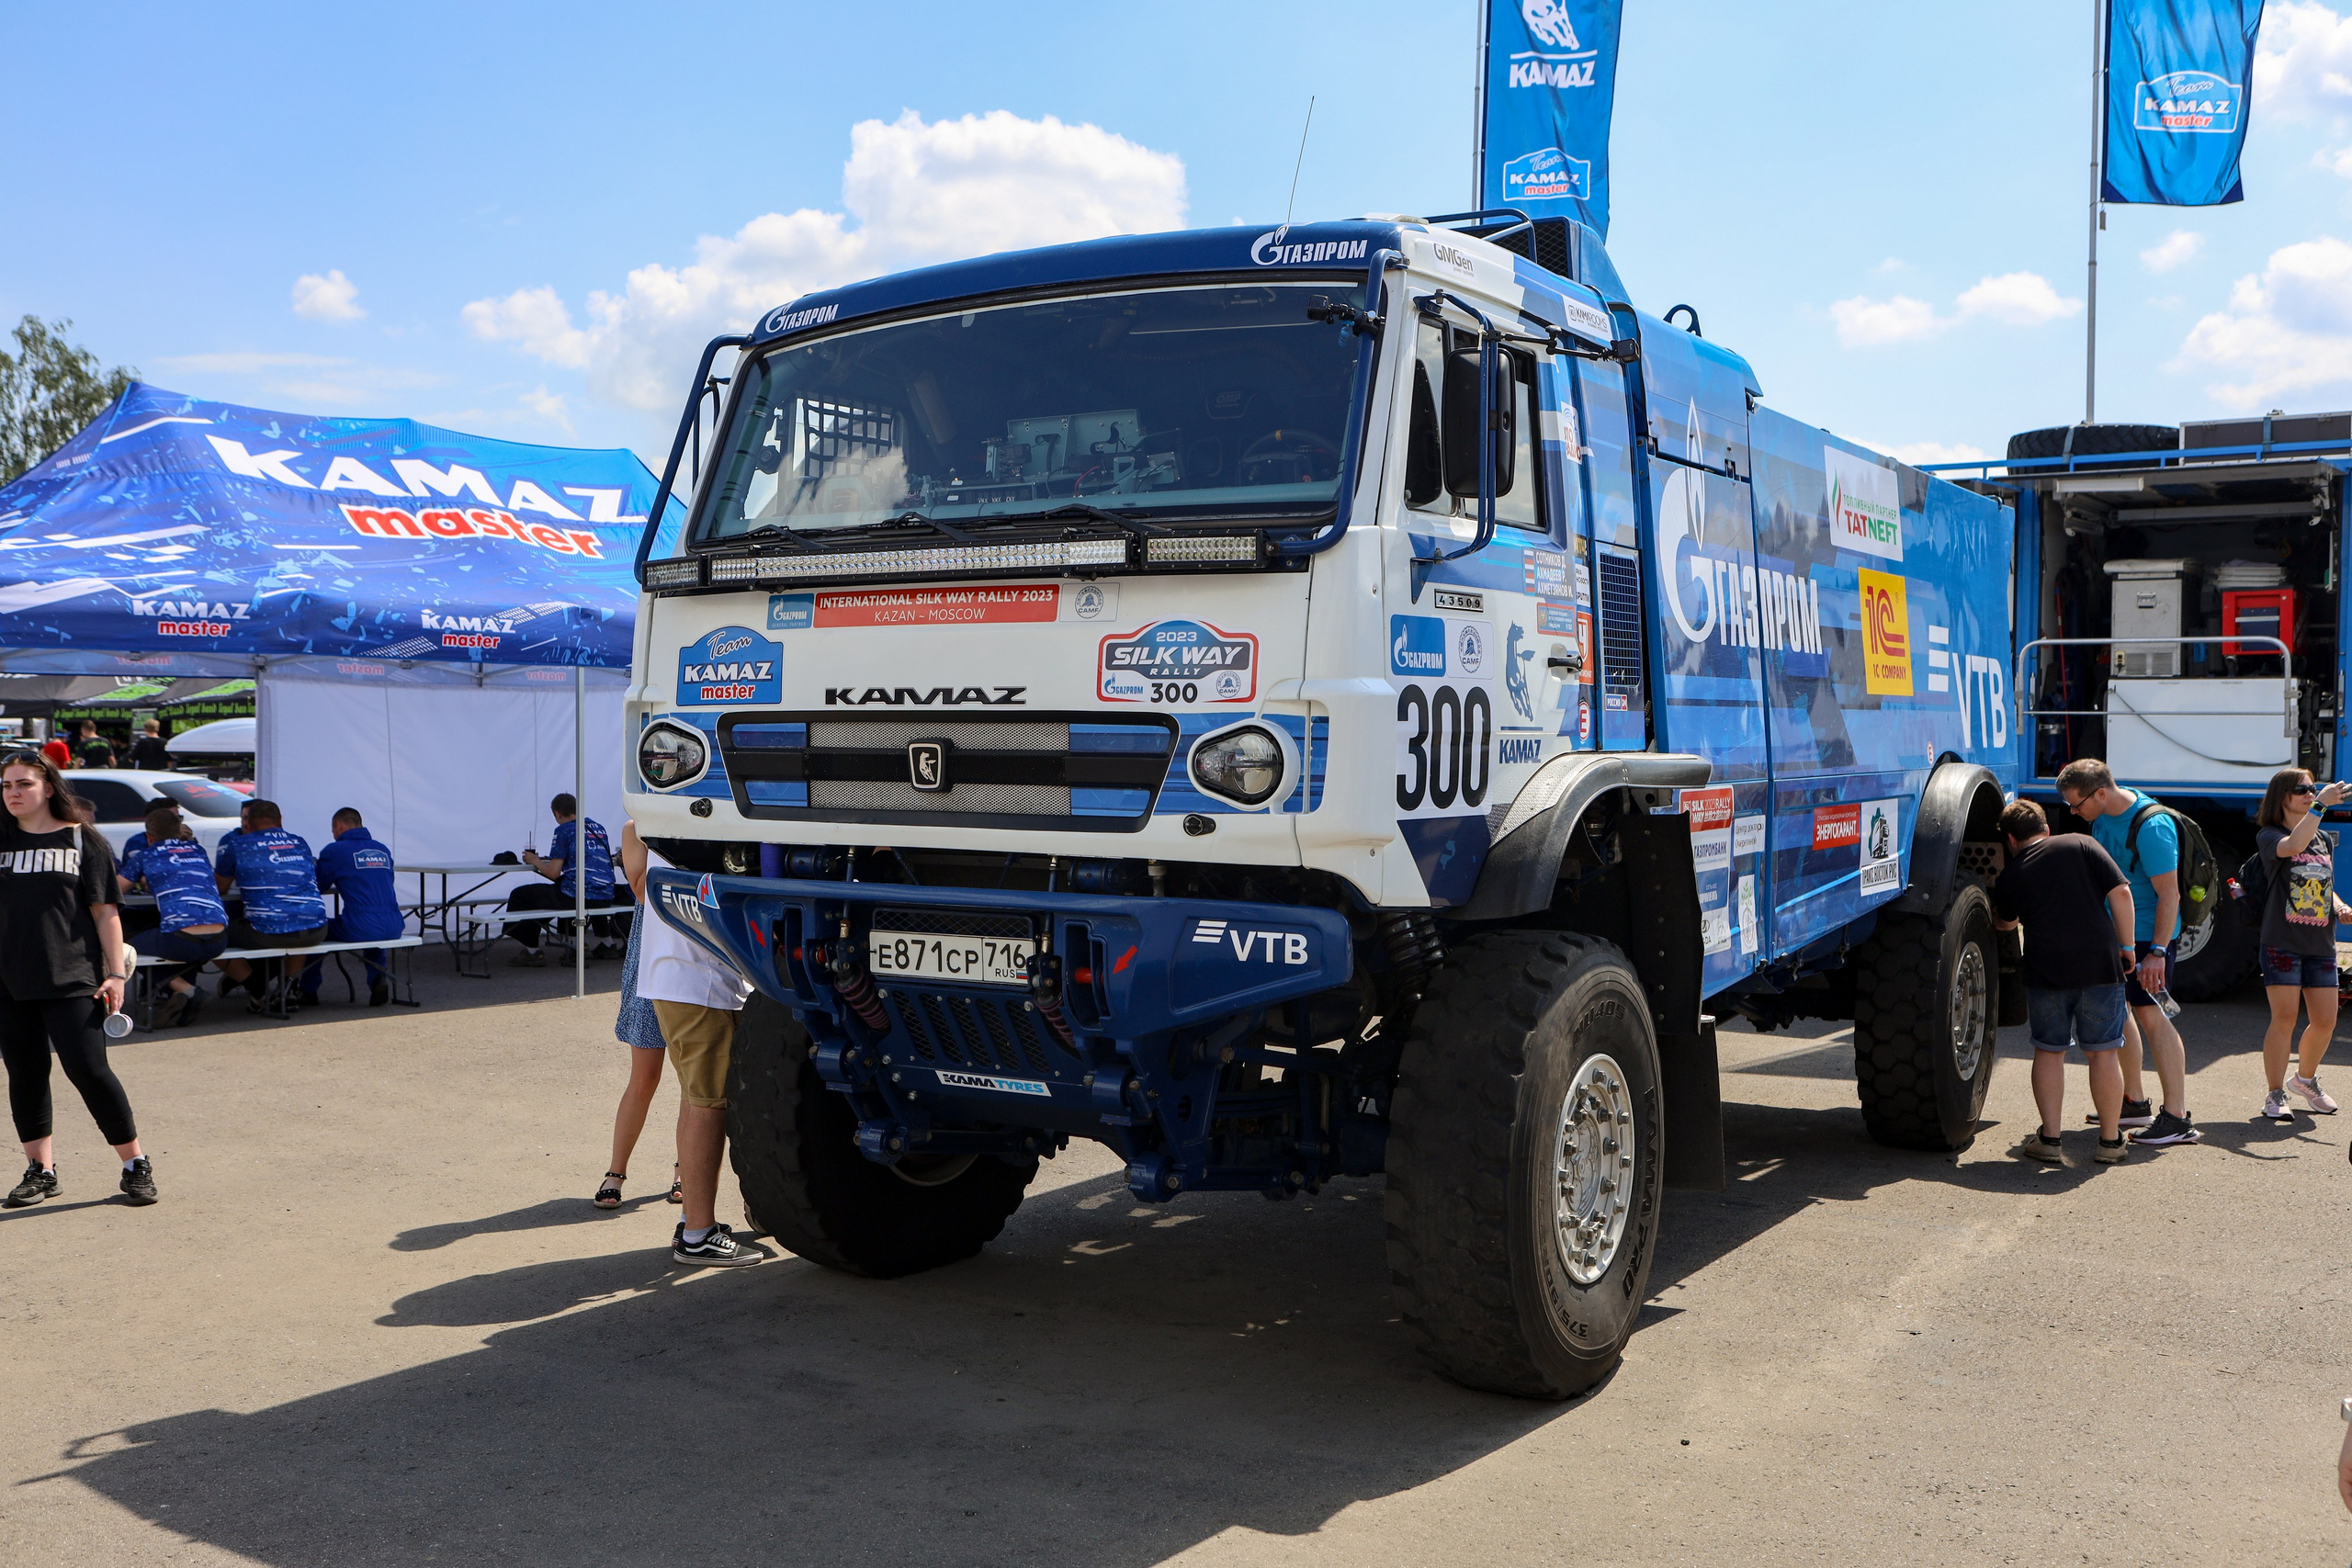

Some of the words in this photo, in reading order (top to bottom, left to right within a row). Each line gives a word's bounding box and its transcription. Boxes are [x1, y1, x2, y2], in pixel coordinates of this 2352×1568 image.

[1510, 61, 1595, 88] KAMAZ
[2166, 76, 2214, 97] Team
[2144, 97, 2231, 114] KAMAZ
[2161, 115, 2212, 127] master
[1530, 153, 1564, 172] Team
[1510, 172, 1580, 185] KAMAZ
[1524, 185, 1569, 196] master
[1284, 239, 1367, 265] ГАЗПРОМ
[1433, 243, 1474, 272] GMGen
[782, 304, 839, 329] ГАЗПРОМ
[206, 434, 647, 525] KAMAZ
[1843, 494, 1875, 514] ТОПЛИВНЫЙ
[1876, 505, 1897, 520] ПАРТНЕР
[338, 502, 605, 559] master
[1844, 510, 1897, 546] TATNEFT
[1536, 552, 1561, 567] СОТНИКОВ
[1537, 567, 1561, 582] АХМАДЕЕВ
[1537, 581, 1567, 597] АХМЕТЗЯНОВ
[820, 594, 912, 608] INTERNATIONAL
[915, 593, 943, 604] SILK
[946, 592, 975, 604] WAY
[978, 591, 1021, 603] RALLY
[1023, 590, 1054, 602] 2023
[1714, 558, 1823, 655] ГАЗПРОМ
[132, 600, 251, 620] KAMAZ
[783, 611, 807, 620] GAZPROM
[874, 610, 916, 622] KAZAN
[928, 608, 987, 620] MOSCOW
[157, 619, 231, 638] master
[421, 608, 515, 634] KAMAZ
[441, 632, 502, 649] master
[707, 631, 752, 660] Team
[1156, 631, 1197, 642] 2023
[1112, 647, 1179, 665] SILK
[1182, 647, 1243, 665] WAY
[1408, 652, 1443, 670] GAZPROM
[684, 661, 774, 682] KAMAZ
[1149, 668, 1202, 676] RALLY
[1882, 664, 1906, 680] COMPANY
[701, 683, 755, 700] master
[826, 687, 1027, 706] KAMAZ
[1115, 686, 1143, 694] GAZPROM
[1150, 682, 1198, 703] 300
[1952, 652, 2007, 749] VTB
[1396, 684, 1490, 811] 300
[1499, 739, 1542, 763] KAMAZ
[1692, 800, 1704, 811] SILK
[1715, 797, 1731, 809] RALLY
[1692, 811, 1704, 823] WAY
[1816, 820, 1857, 841] ЭНЕРГОГАРАНТ
[1694, 841, 1727, 858] ГАЗПРОМБАНК
[672, 893, 702, 923] VTB
[985, 942, 1026, 968] 716
[1229, 930, 1308, 964] VTB
[995, 968, 1015, 978] RUS
[1623, 1219, 1648, 1301] PRO
